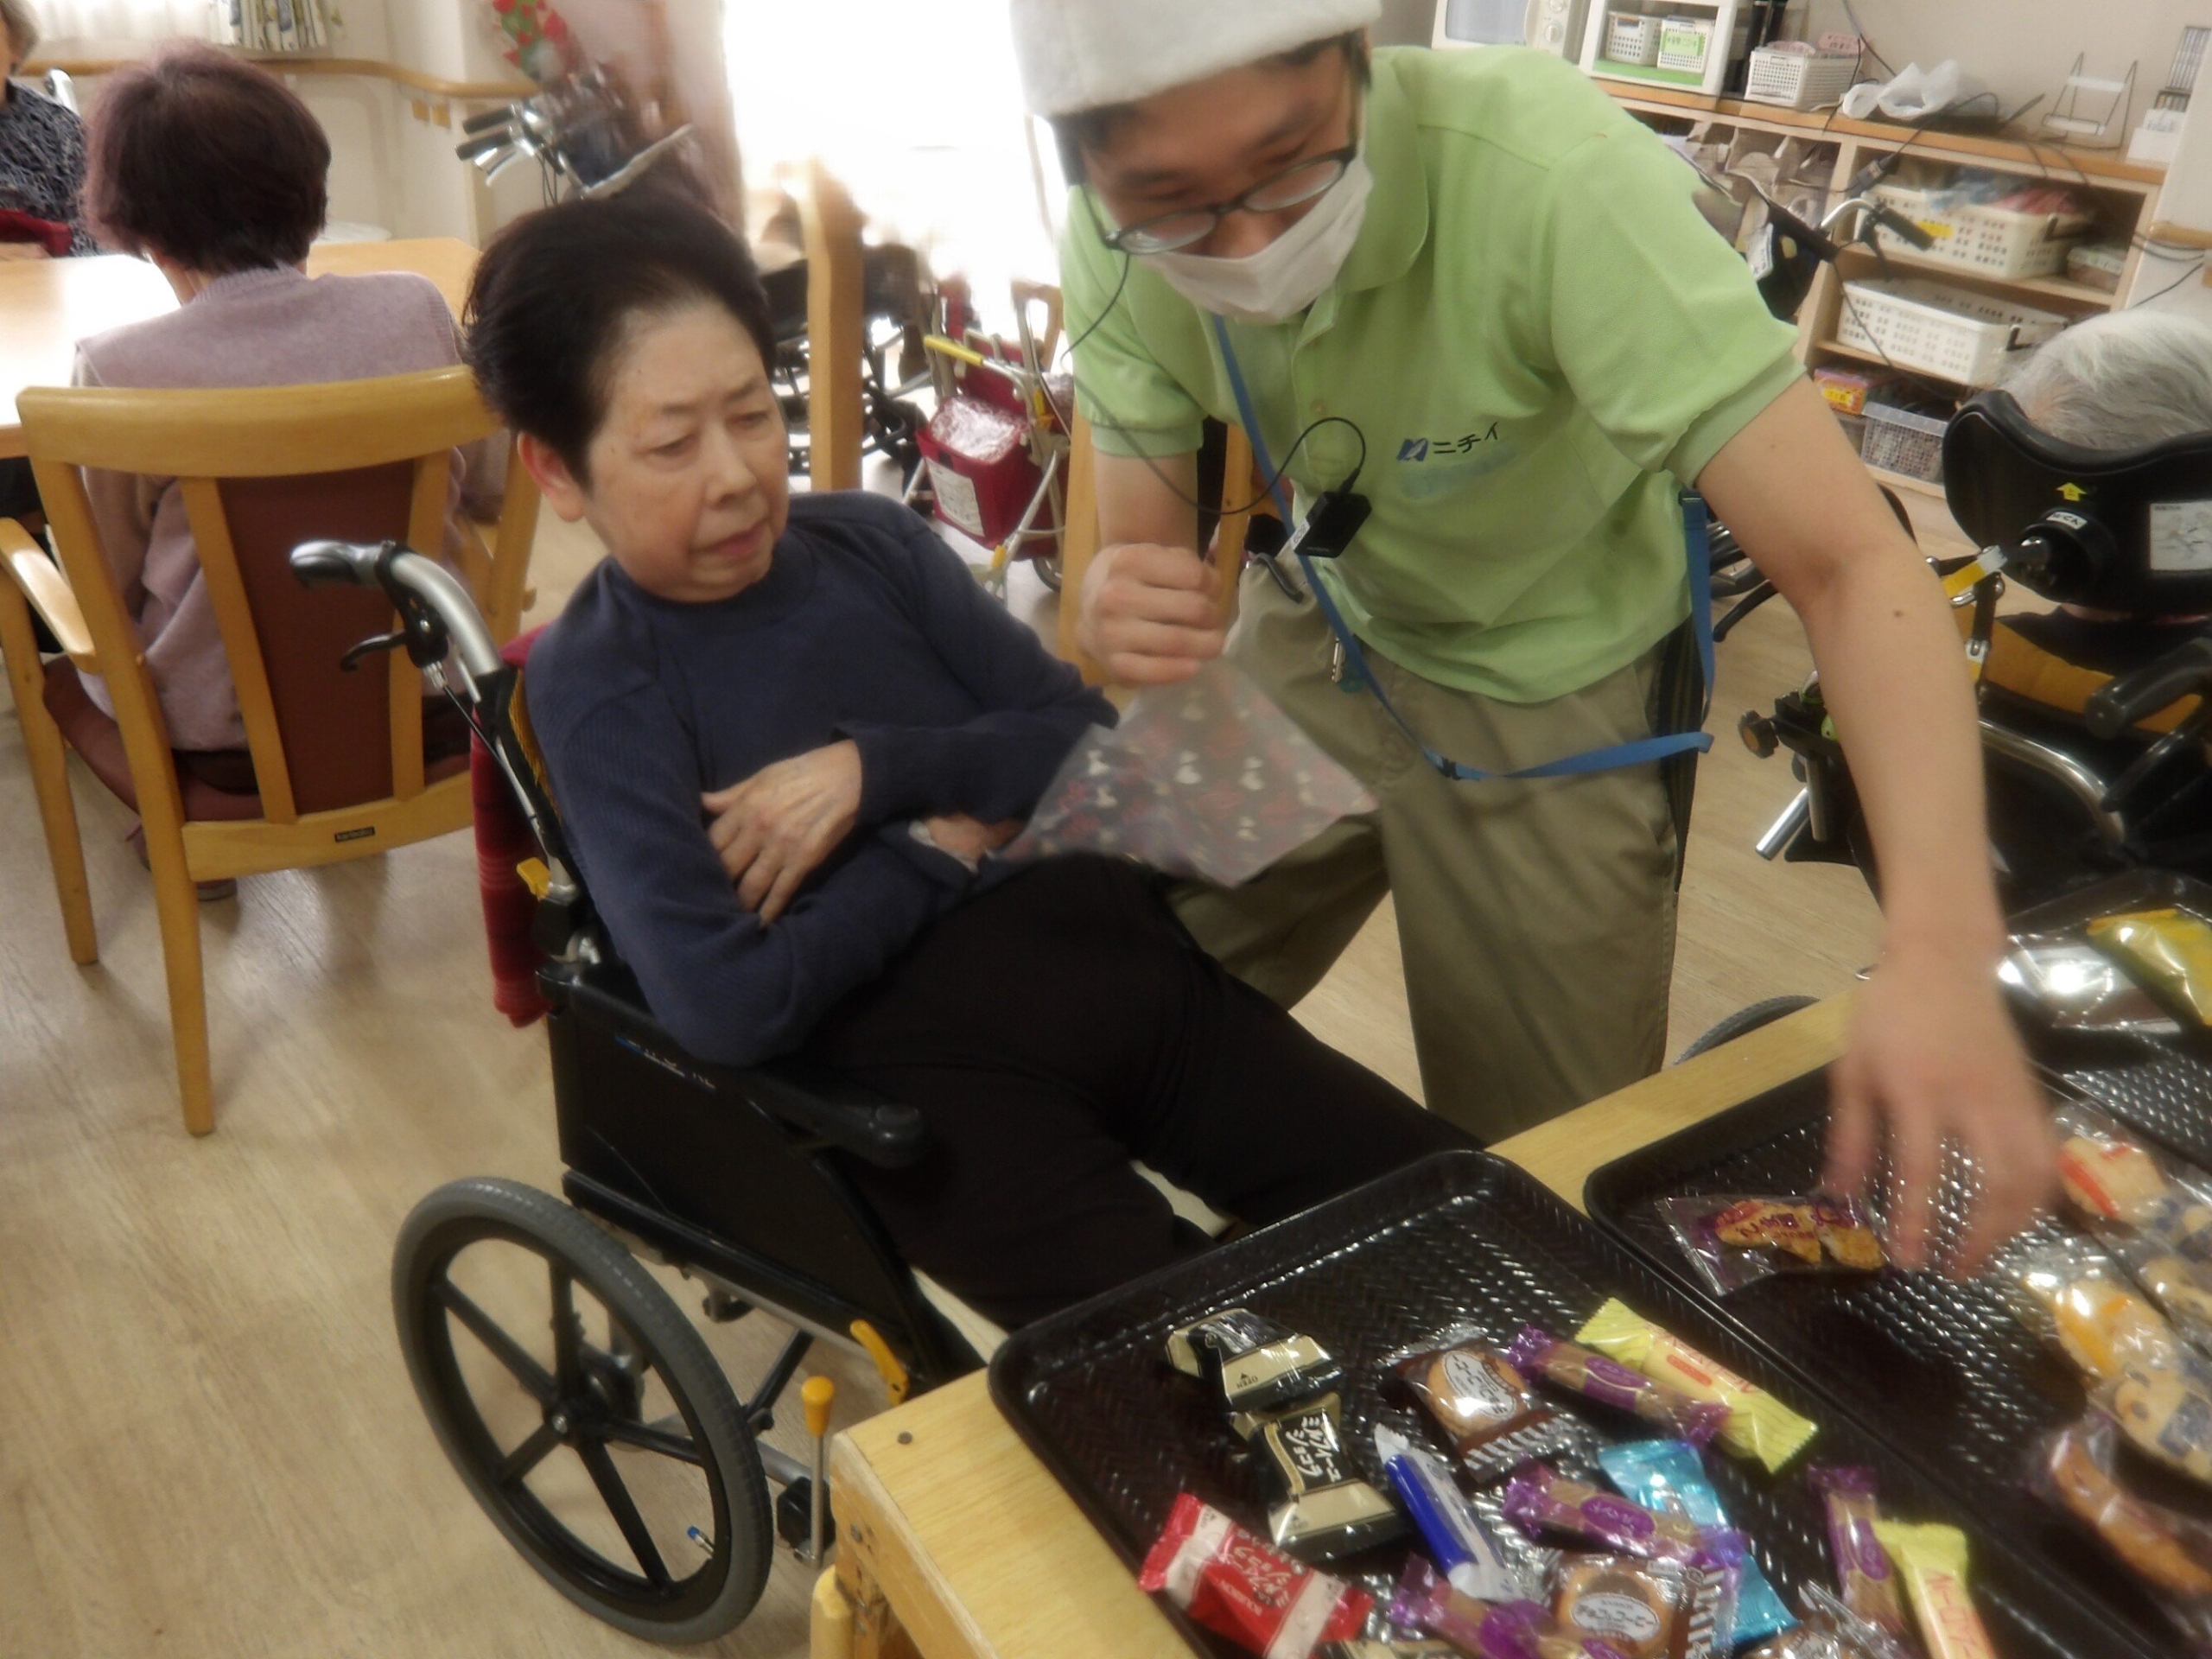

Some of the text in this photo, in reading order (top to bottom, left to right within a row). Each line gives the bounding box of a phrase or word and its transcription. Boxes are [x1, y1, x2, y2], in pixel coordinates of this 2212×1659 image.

[1433, 422, 1498, 454] ニチイ
[1285, 1428, 1324, 1477] ショコラ
